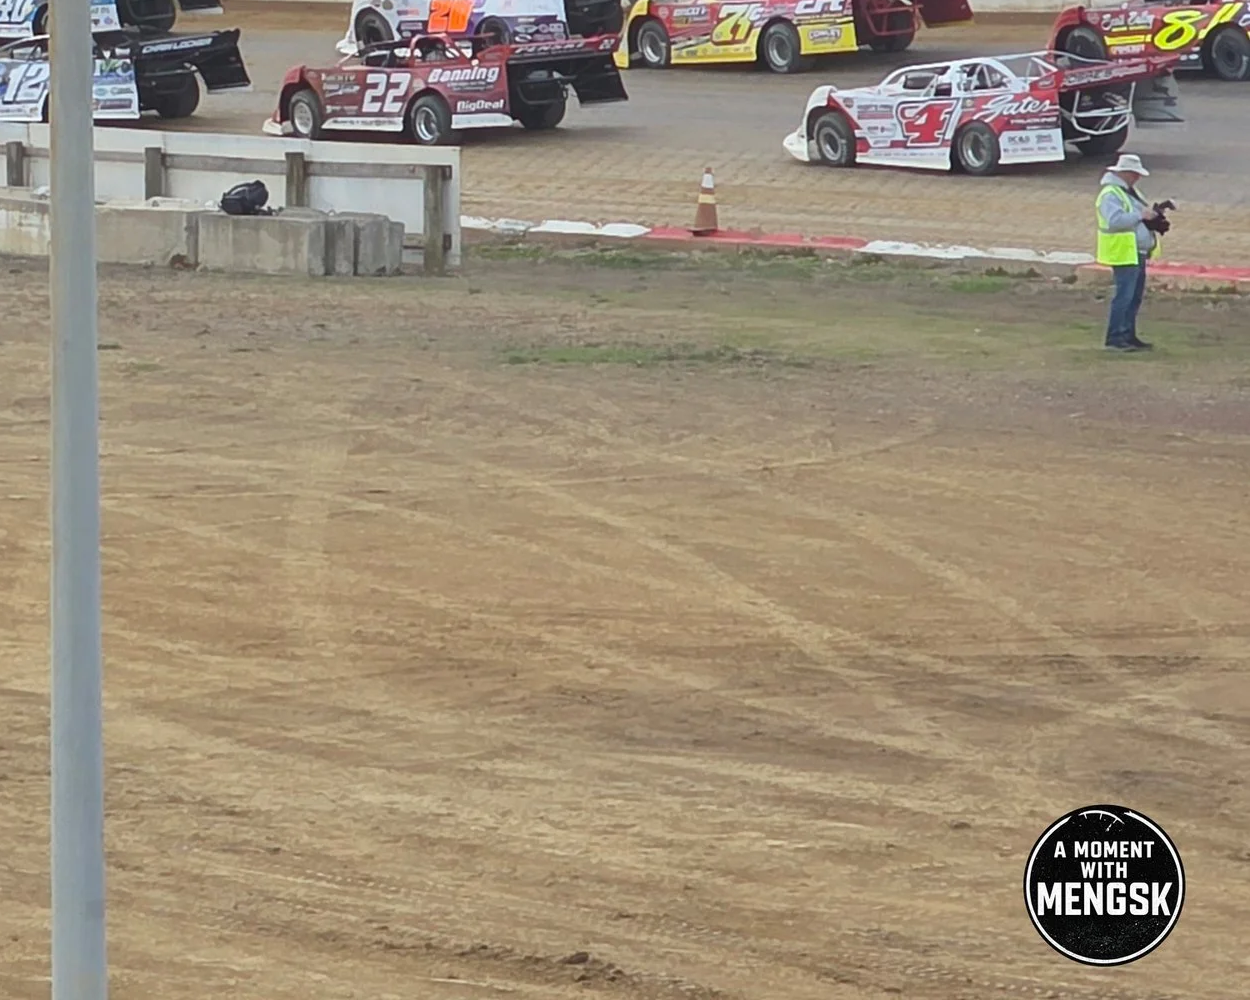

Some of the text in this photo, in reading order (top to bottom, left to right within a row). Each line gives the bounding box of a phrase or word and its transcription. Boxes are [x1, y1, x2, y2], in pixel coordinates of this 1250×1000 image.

[1154, 10, 1208, 50] 8
[3, 63, 50, 104] 12
[362, 73, 410, 113] 22
